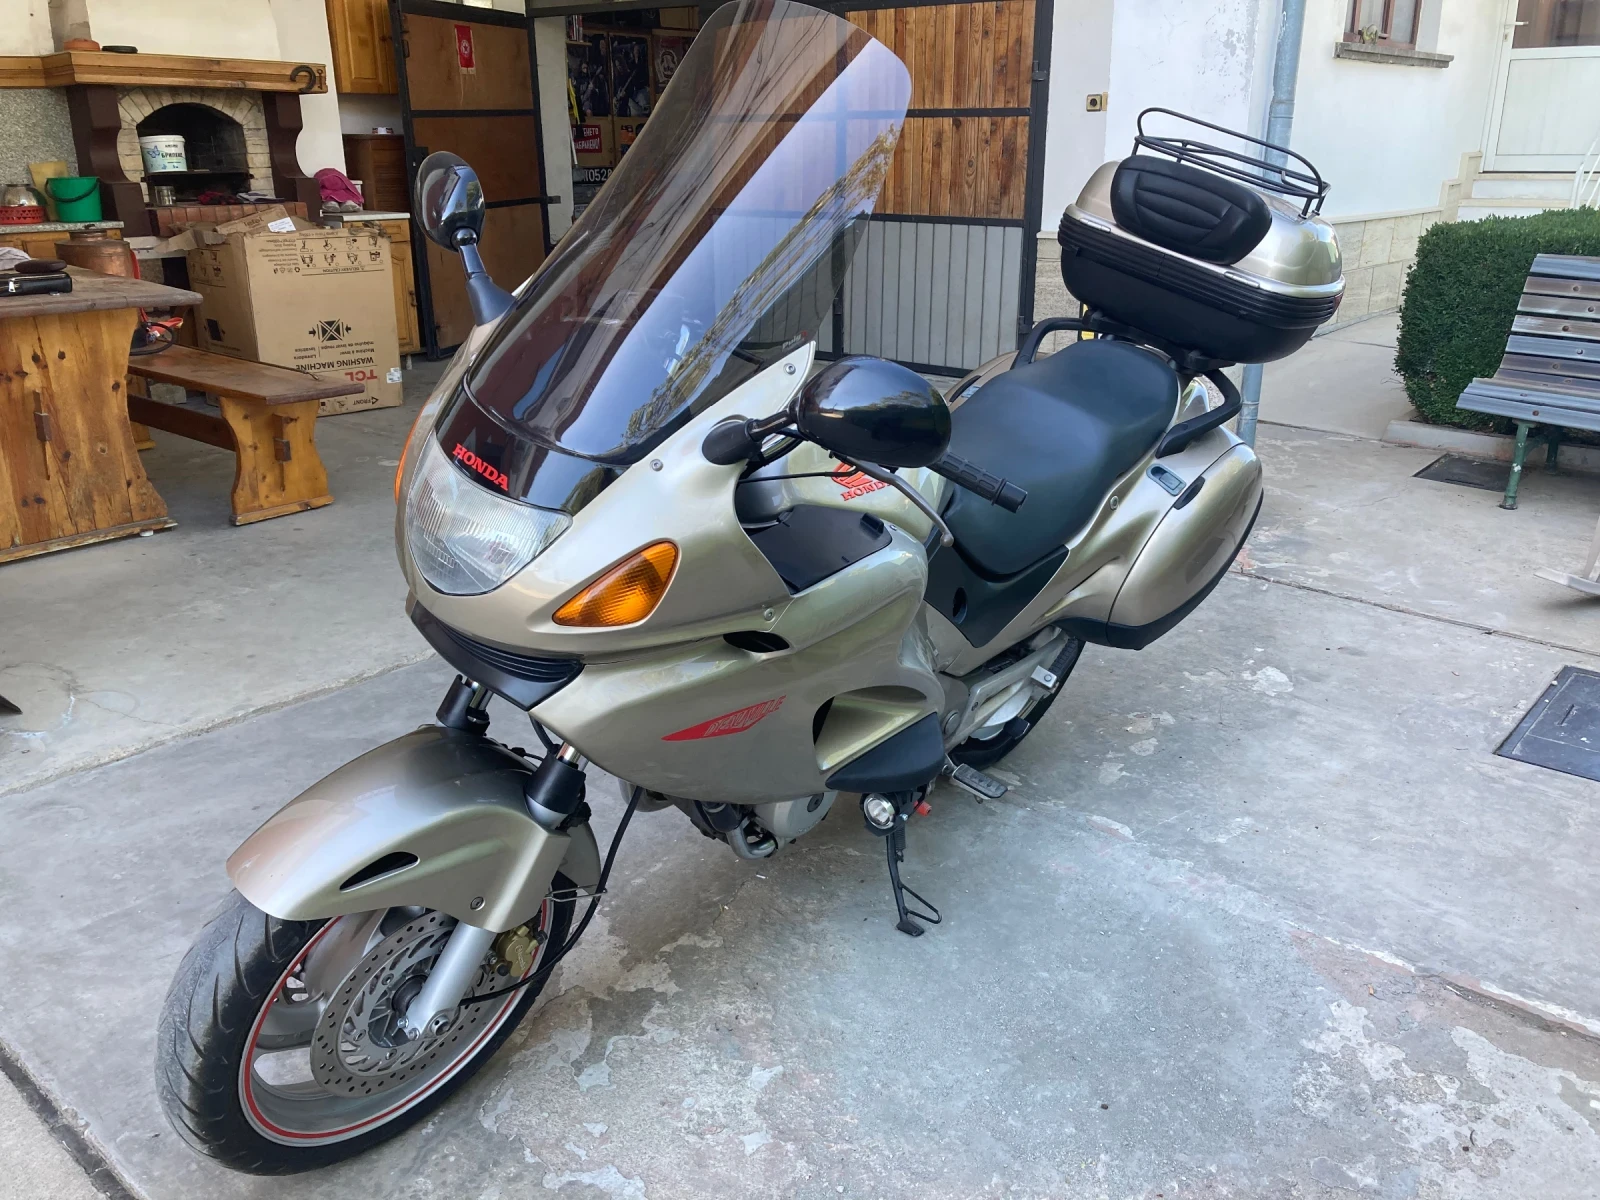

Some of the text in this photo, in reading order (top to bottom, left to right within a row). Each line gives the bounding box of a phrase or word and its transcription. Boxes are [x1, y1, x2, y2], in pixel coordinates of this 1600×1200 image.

[295, 356, 374, 371] WASHING MACHINE
[344, 369, 378, 382] TCL
[352, 398, 371, 406] FRONT
[452, 443, 510, 492] HONDA
[840, 480, 892, 502] HOND
